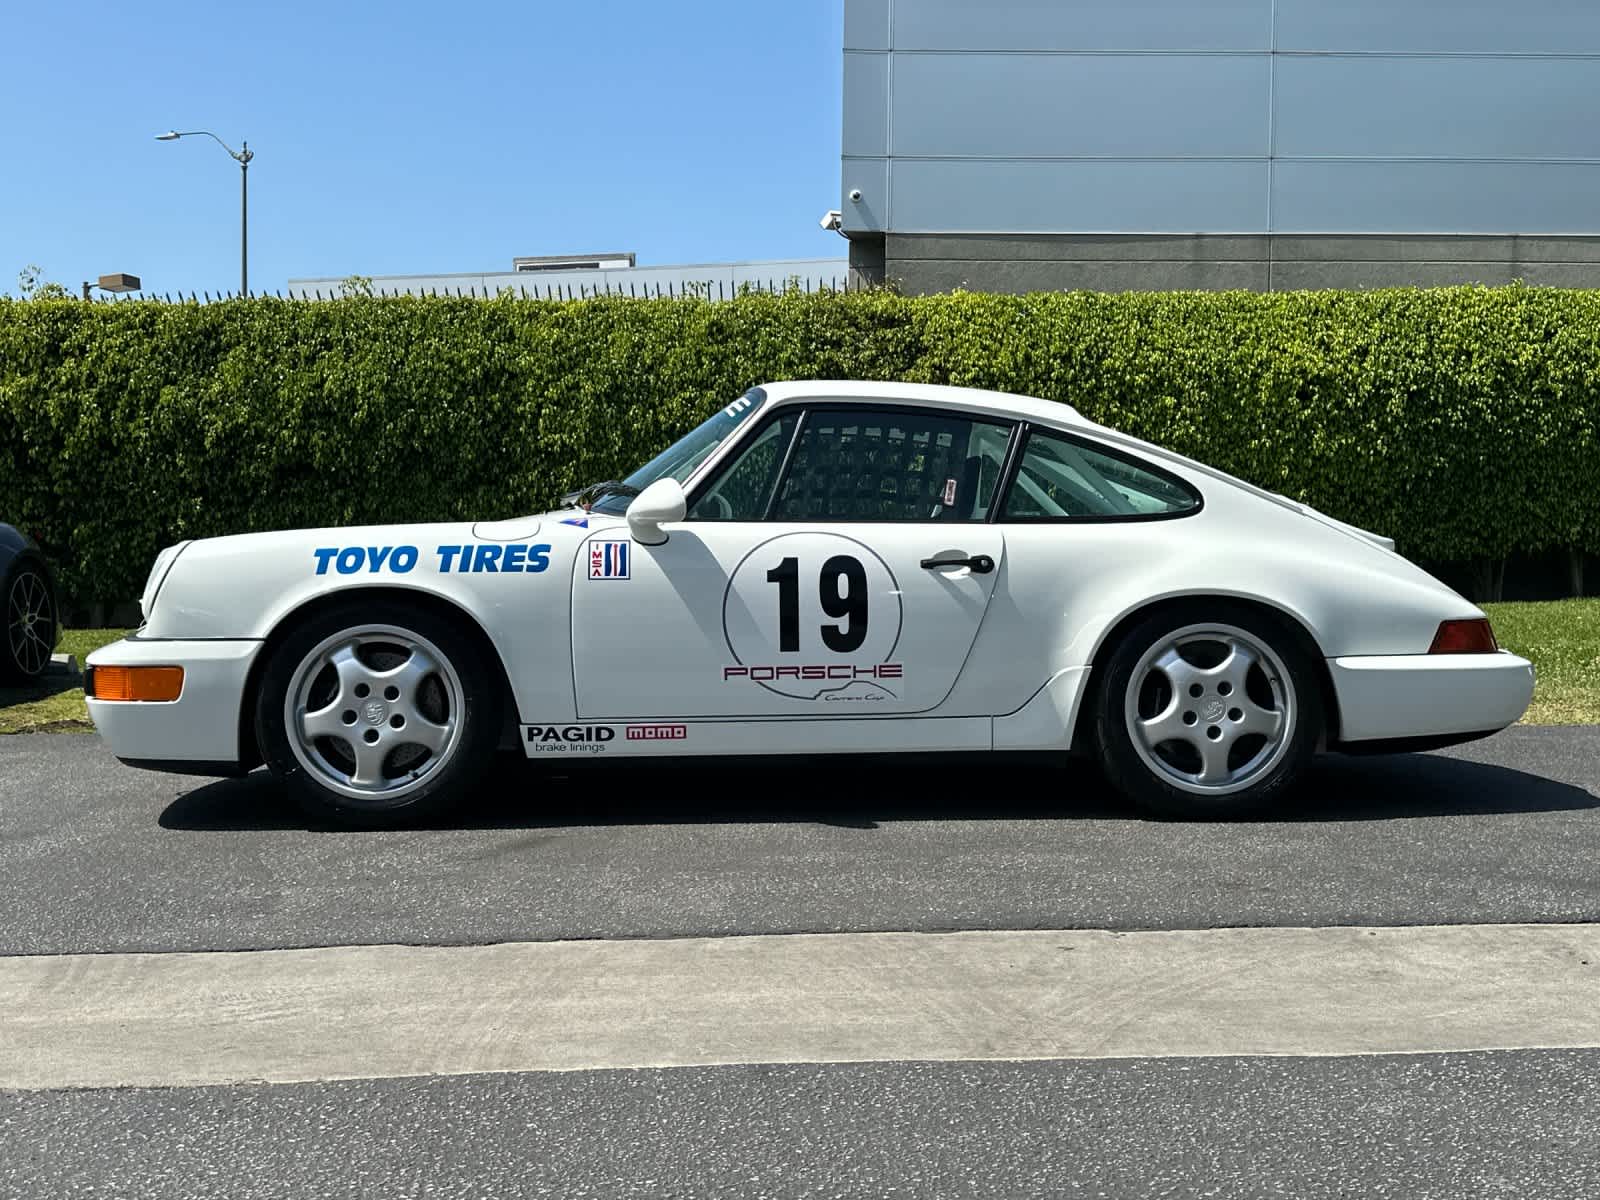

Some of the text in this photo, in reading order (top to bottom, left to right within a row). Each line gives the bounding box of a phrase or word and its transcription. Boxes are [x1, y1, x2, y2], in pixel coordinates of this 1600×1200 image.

[313, 544, 552, 575] TOYO TIRES
[591, 543, 603, 577] IMSA
[766, 554, 869, 653] 19
[723, 664, 903, 681] PORSCHE
[527, 726, 616, 742] PAGID
[535, 742, 606, 754] brake linings
